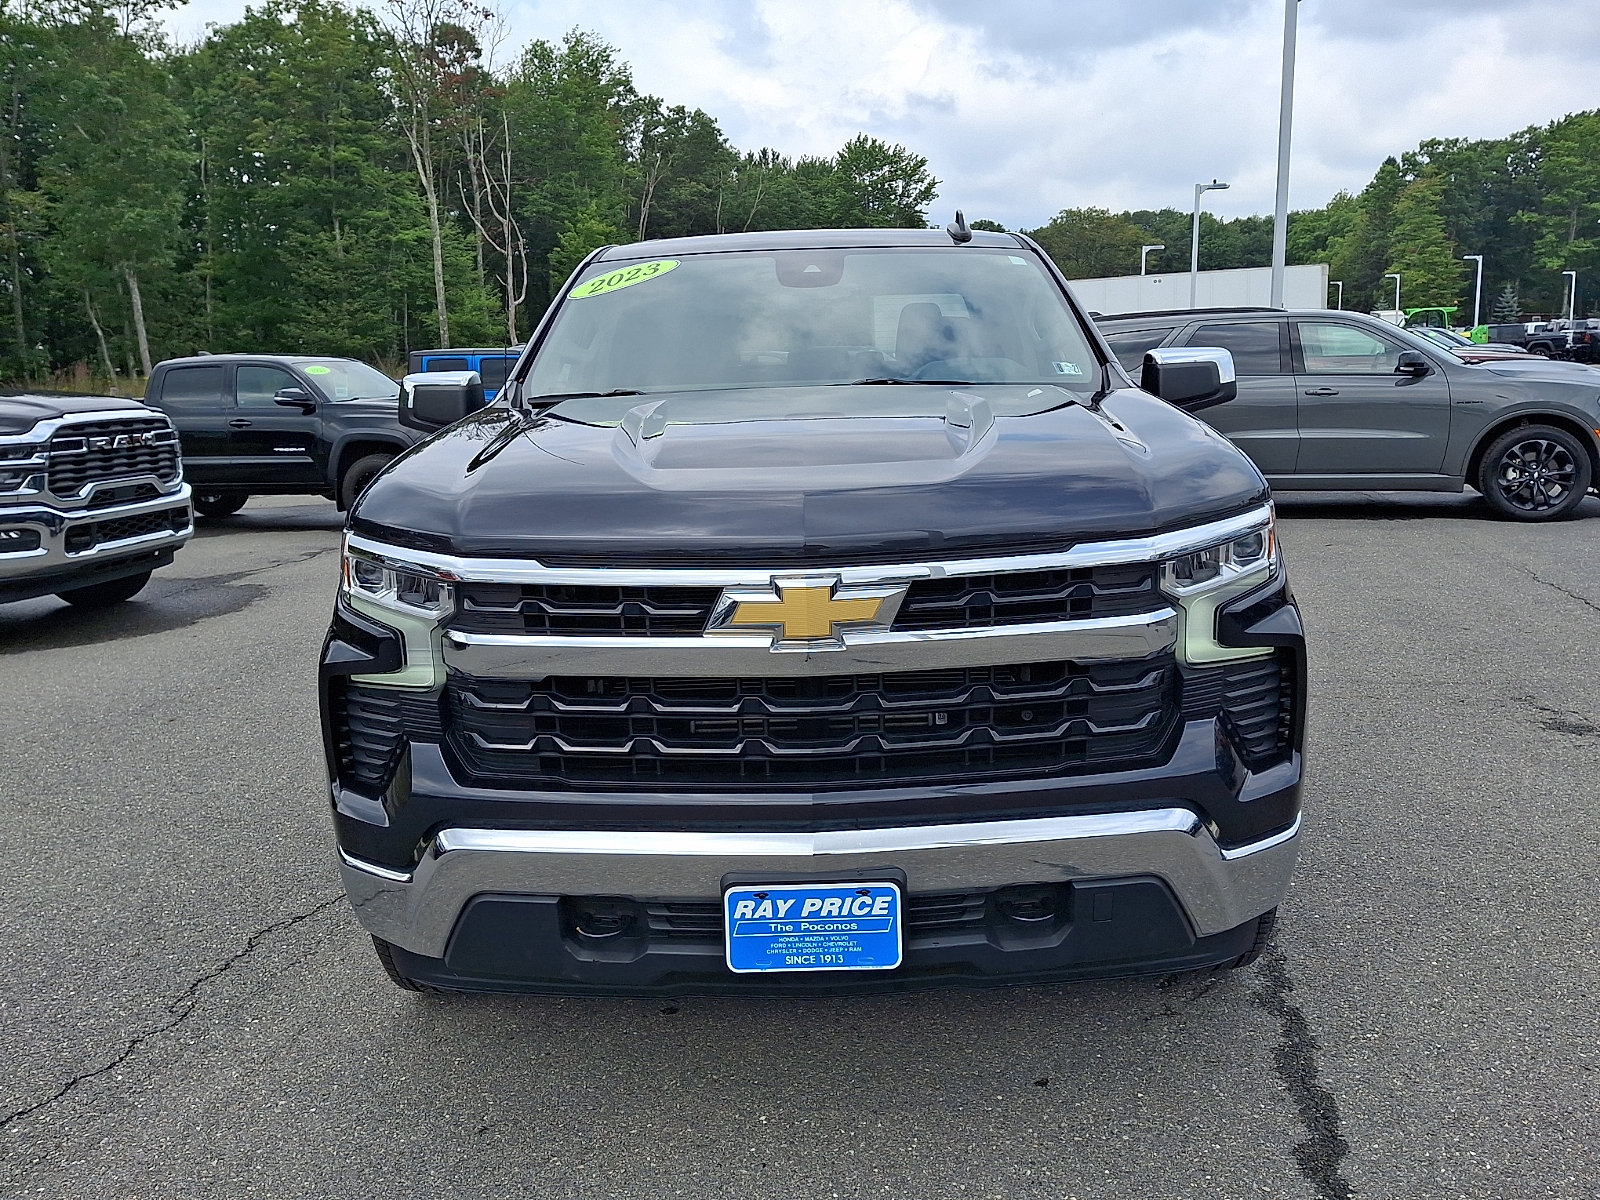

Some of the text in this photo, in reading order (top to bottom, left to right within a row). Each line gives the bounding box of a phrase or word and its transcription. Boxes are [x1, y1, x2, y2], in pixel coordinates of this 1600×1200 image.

[588, 262, 661, 295] 2023
[88, 433, 155, 451] RAM
[733, 896, 892, 919] RAY PRICE
[769, 922, 858, 932] The Poconos
[785, 954, 844, 965] SINCE 1913
